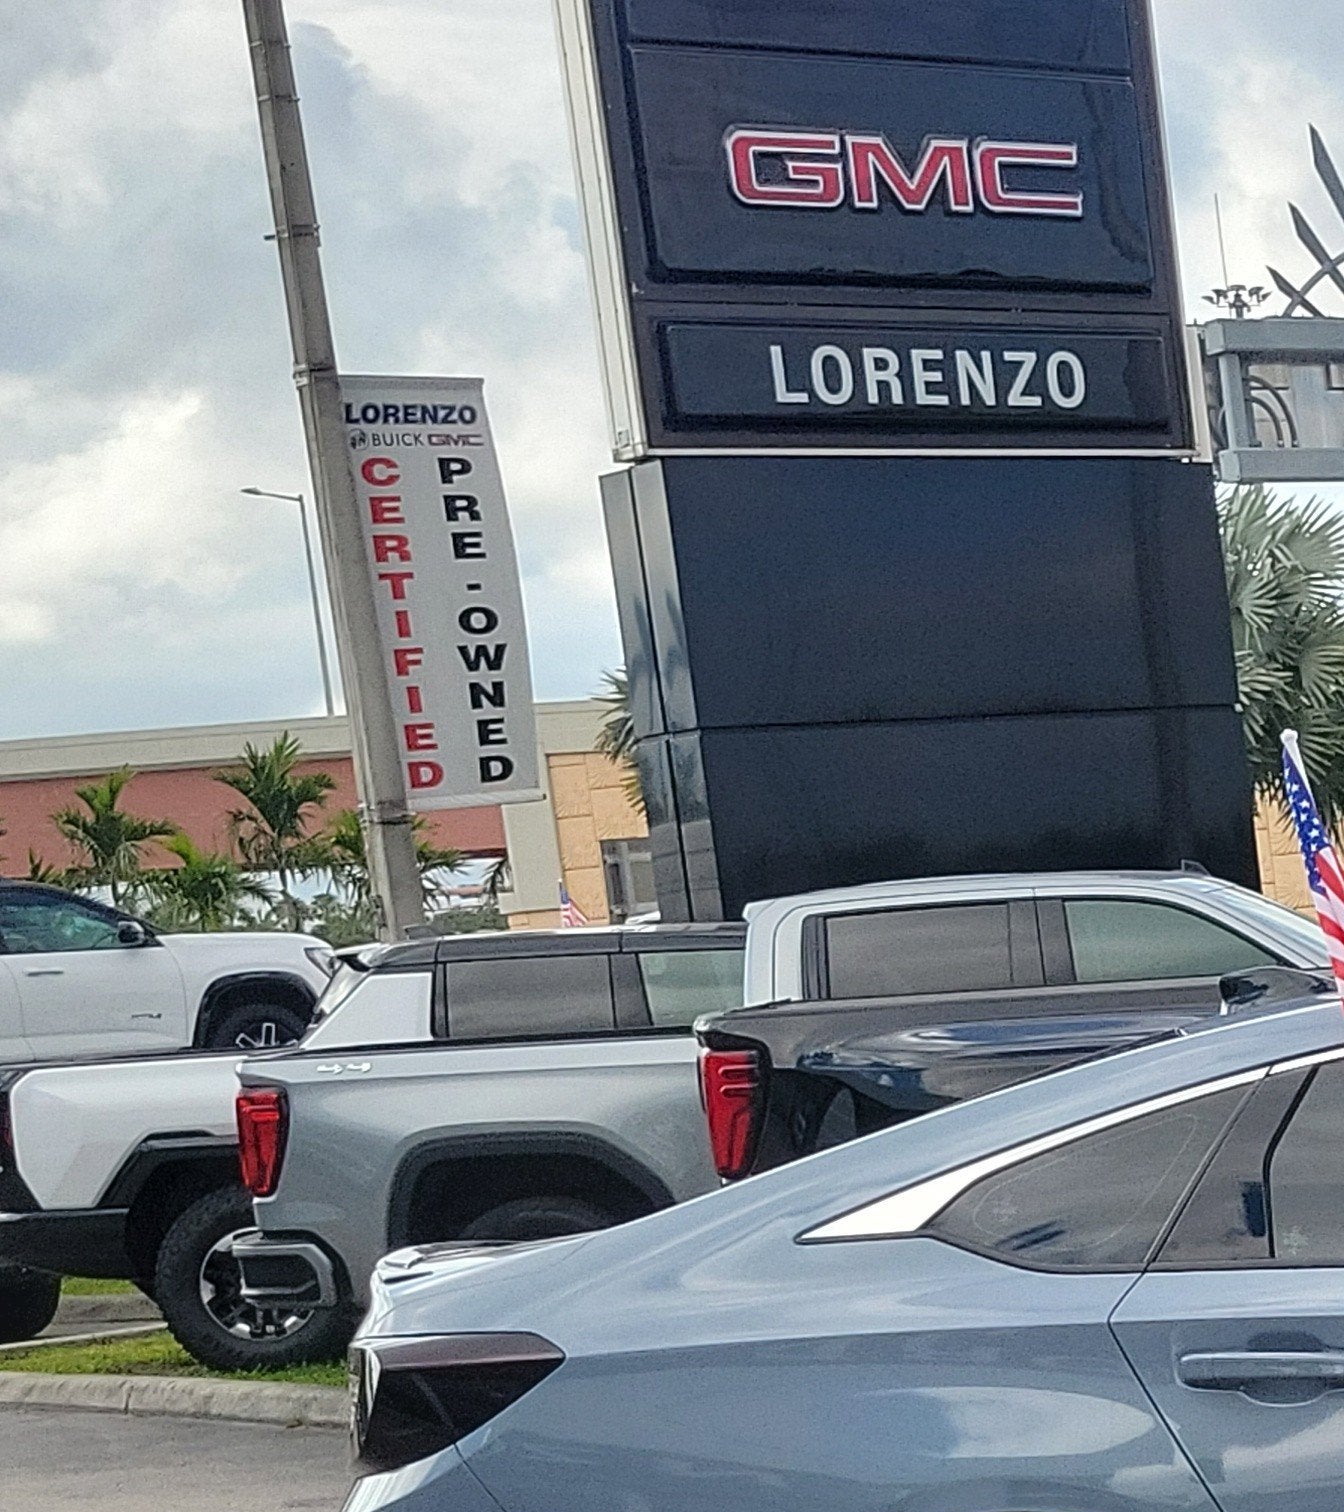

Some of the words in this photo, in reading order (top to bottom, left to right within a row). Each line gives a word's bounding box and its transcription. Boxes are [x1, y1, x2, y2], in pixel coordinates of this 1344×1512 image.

[725, 125, 1083, 217] GMC
[344, 402, 477, 425] LORENZO
[769, 344, 1087, 409] LORENZO
[372, 433, 423, 447] BUICK
[427, 434, 485, 447] GMC
[360, 457, 445, 790] CERTIFIED
[437, 457, 515, 784] PRE-OWNED
